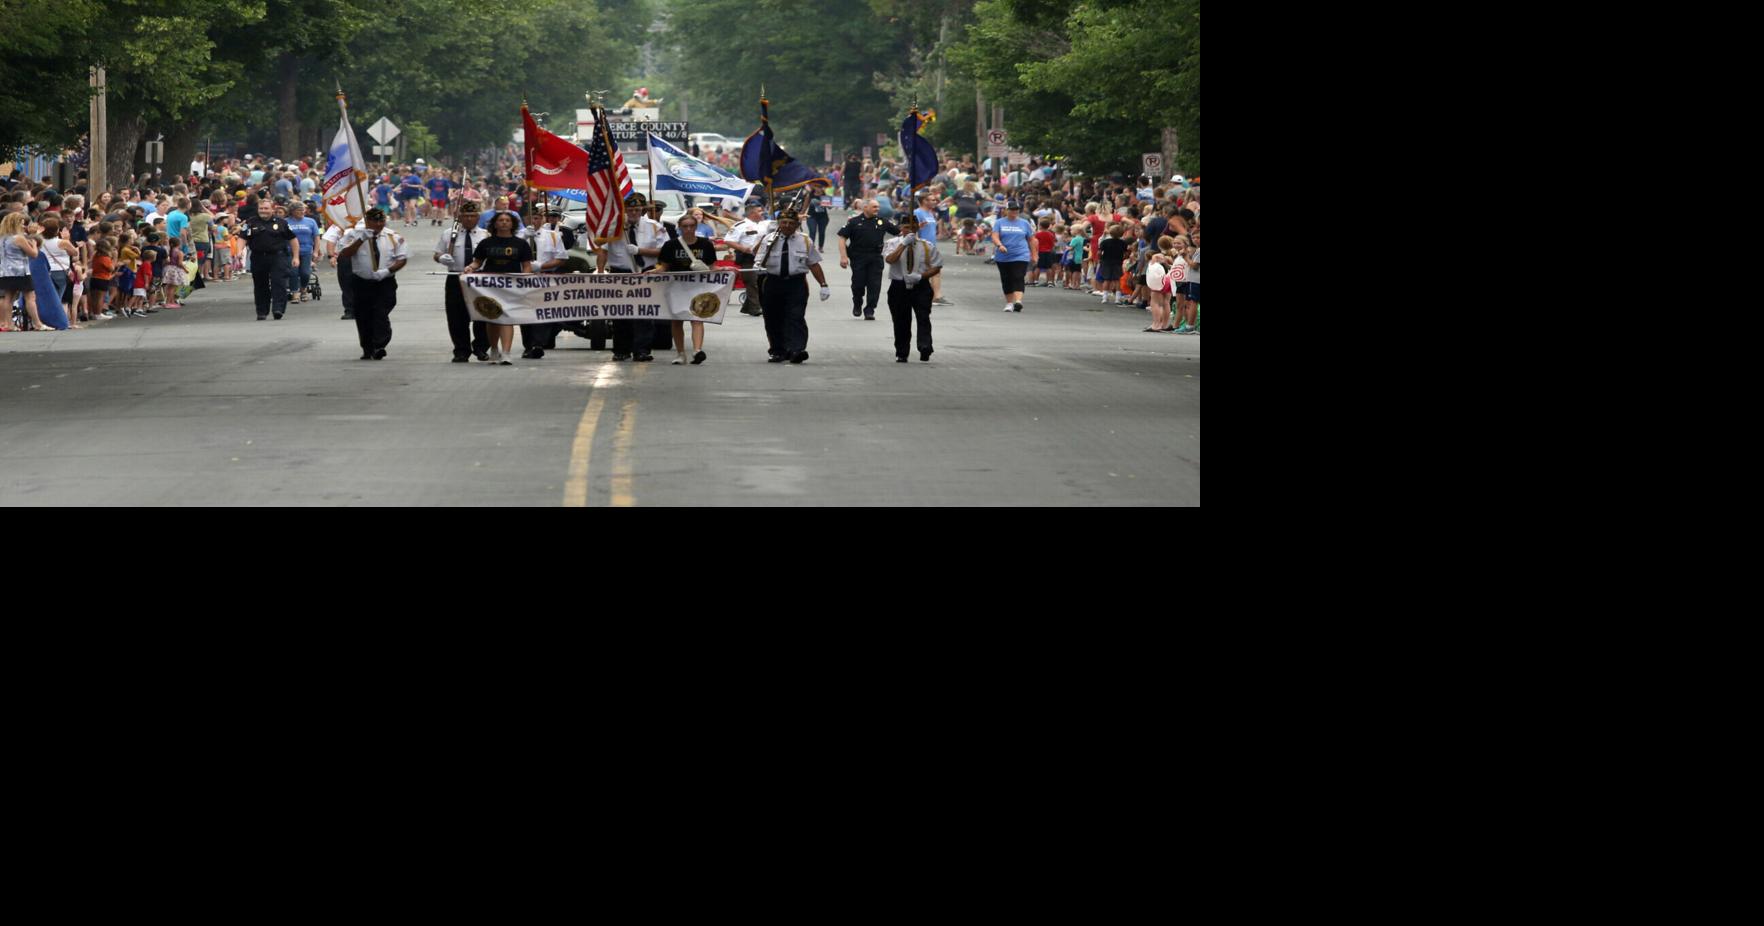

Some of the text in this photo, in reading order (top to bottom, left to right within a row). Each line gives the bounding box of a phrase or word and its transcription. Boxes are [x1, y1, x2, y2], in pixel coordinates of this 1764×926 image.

[609, 122, 687, 131] ERCE COUNTY
[466, 276, 513, 288] PLEASE
[516, 277, 550, 288] SHOW
[553, 276, 585, 285] YOUR
[589, 275, 643, 286] RESPECT
[673, 274, 695, 283] THE
[700, 273, 729, 285] FLAG
[543, 287, 652, 302] BY STANDING AND
[535, 304, 661, 320] REMOVING YOUR HAT
